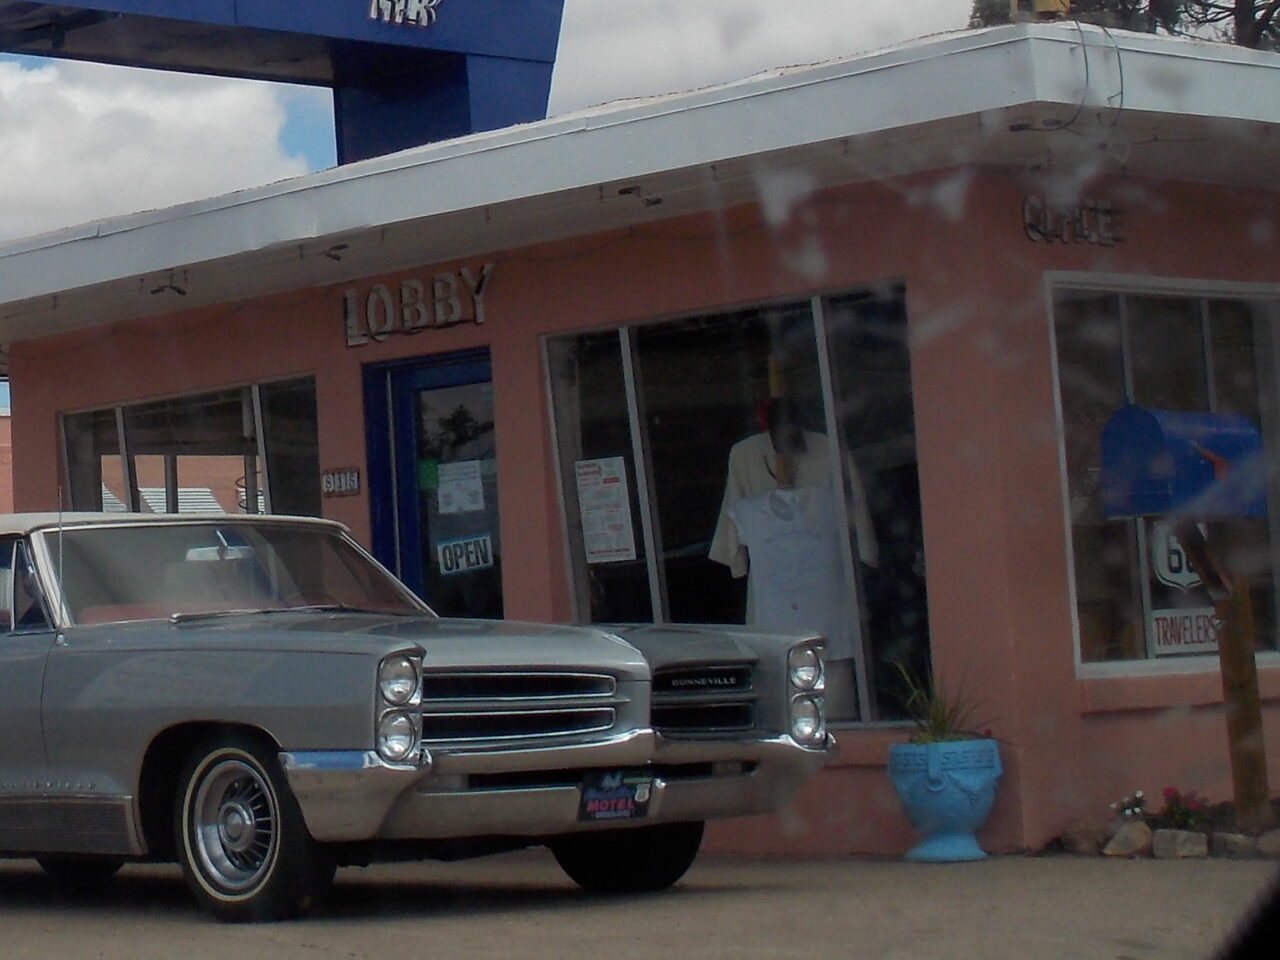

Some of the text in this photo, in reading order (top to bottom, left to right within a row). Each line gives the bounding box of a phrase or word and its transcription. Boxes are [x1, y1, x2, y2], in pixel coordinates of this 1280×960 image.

[344, 264, 494, 347] LOBBY
[325, 471, 357, 489] 815
[441, 539, 489, 572] OPEN
[1154, 613, 1216, 646] TRAVELERS
[671, 677, 737, 687] BONNEVILLE
[587, 799, 634, 813] MOTEL
